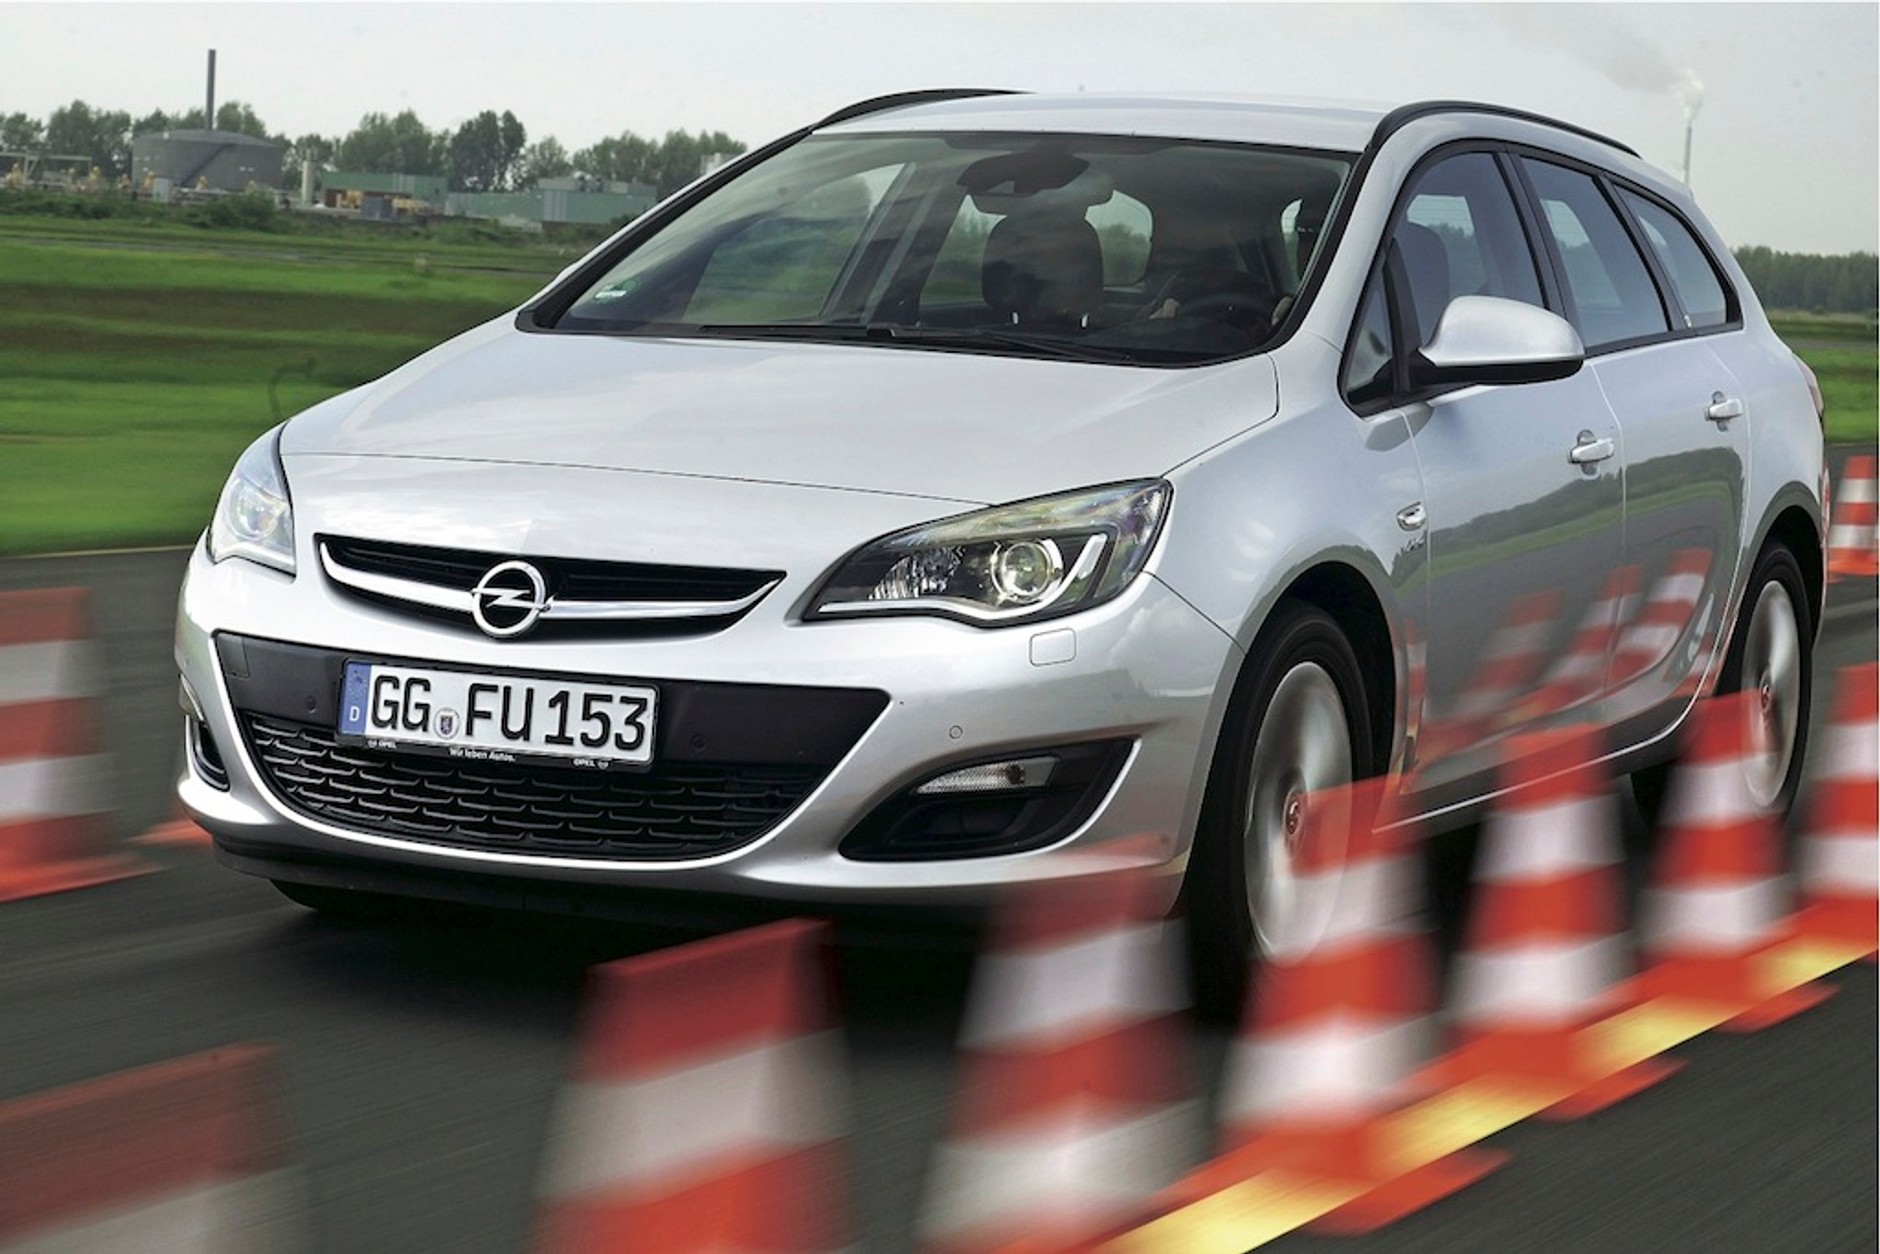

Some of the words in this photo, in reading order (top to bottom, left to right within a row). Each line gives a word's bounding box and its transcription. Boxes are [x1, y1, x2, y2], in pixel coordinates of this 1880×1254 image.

[349, 705, 361, 722] D
[372, 674, 431, 732] GG
[465, 682, 534, 742] FU
[545, 689, 648, 750] 153
